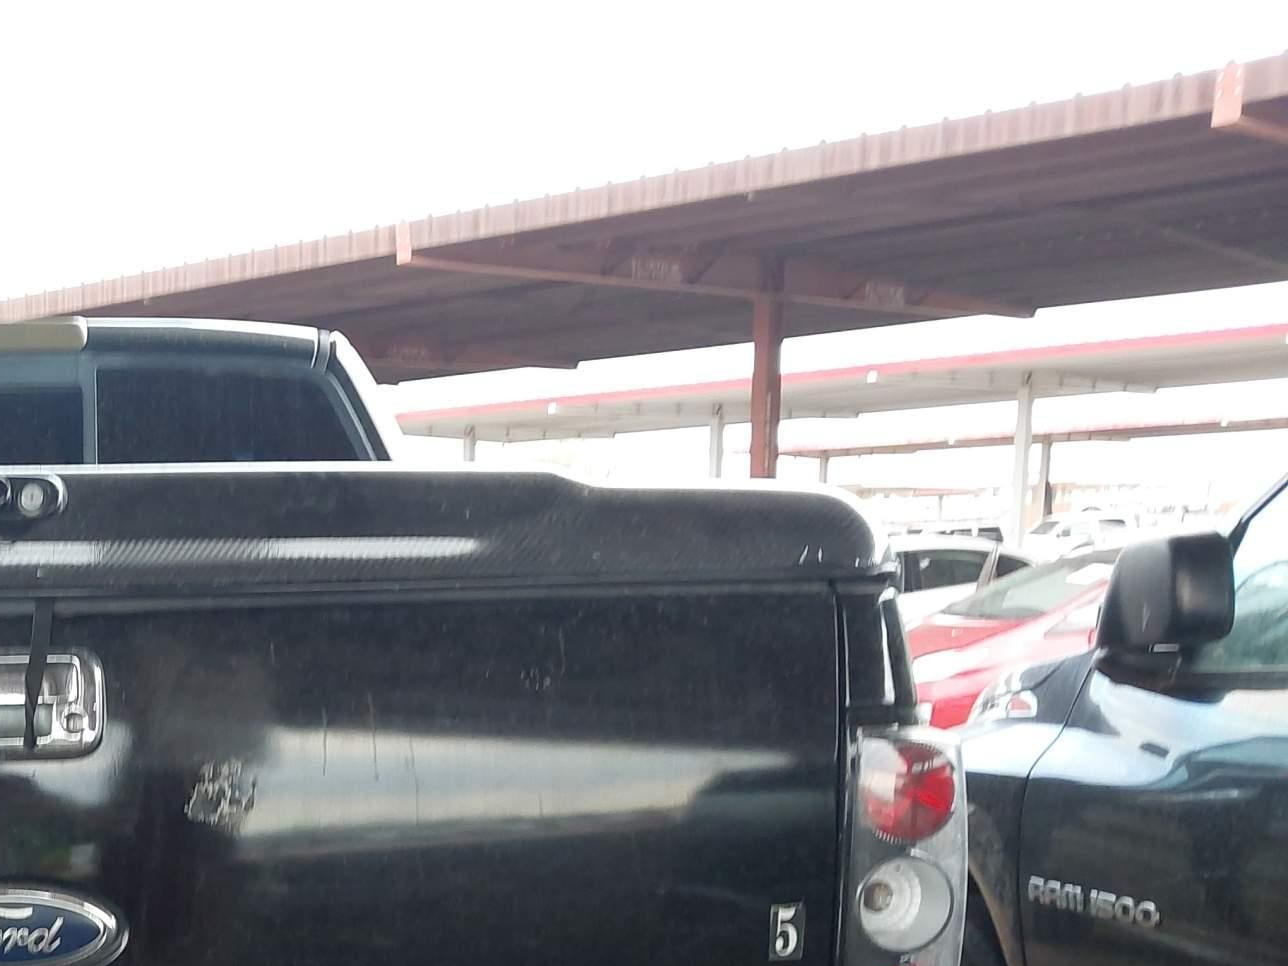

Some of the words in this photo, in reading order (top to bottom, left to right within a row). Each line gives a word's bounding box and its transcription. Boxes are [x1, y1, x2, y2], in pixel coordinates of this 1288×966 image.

[1028, 875, 1084, 913] RAM
[1089, 888, 1160, 928] 1500
[775, 906, 798, 957] 5
